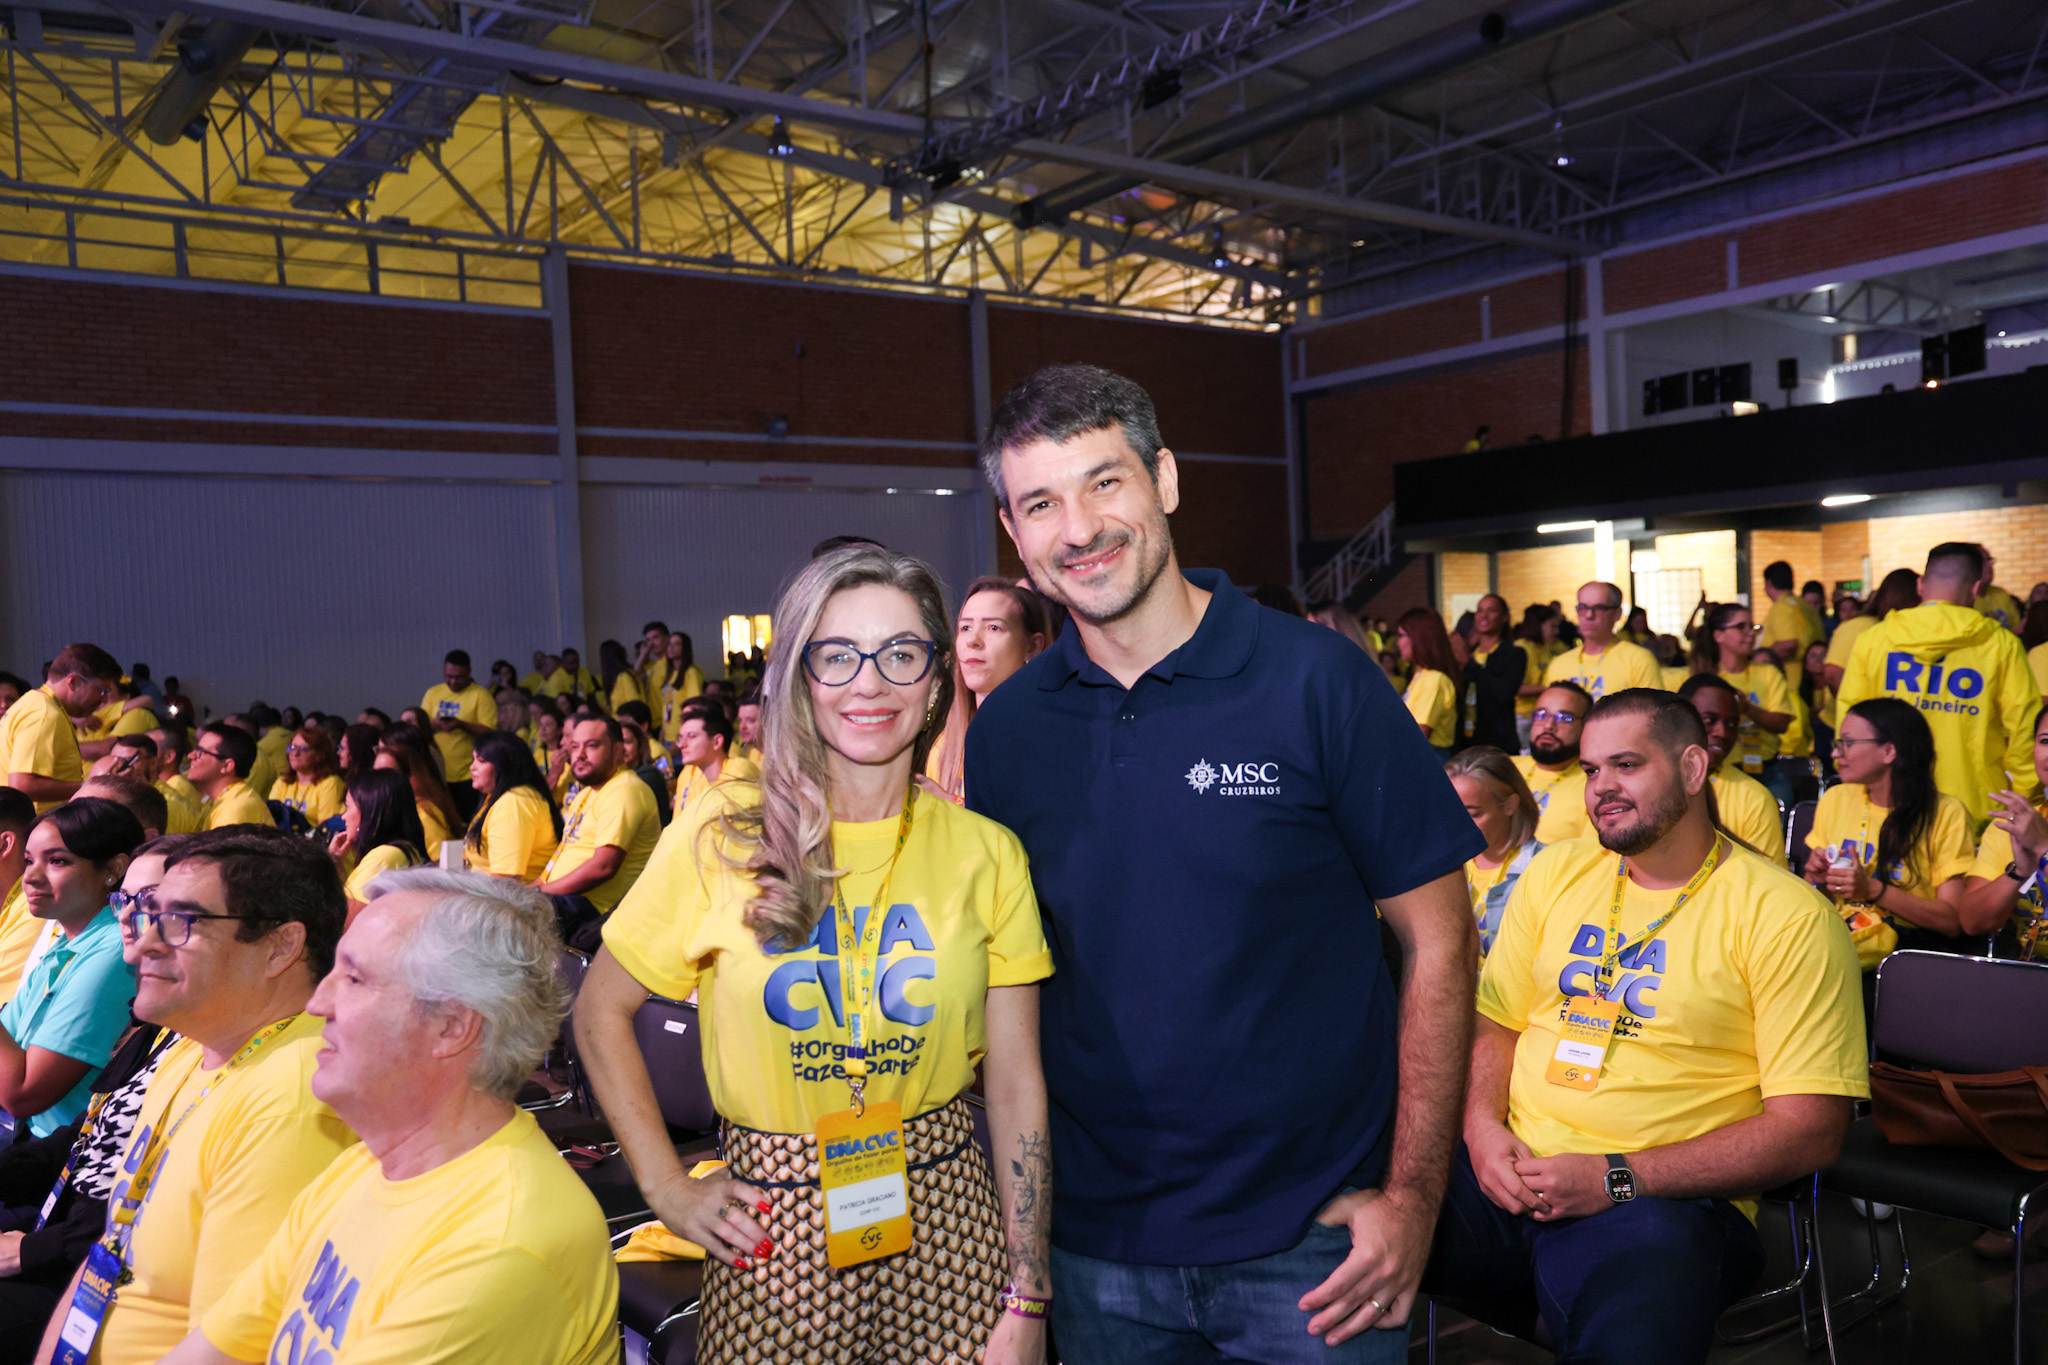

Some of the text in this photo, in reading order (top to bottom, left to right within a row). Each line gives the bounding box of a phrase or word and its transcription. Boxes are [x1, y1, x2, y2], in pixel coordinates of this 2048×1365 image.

[1885, 651, 1984, 699] Rio
[1914, 696, 1980, 716] Janeiro
[1220, 762, 1279, 784] MSC
[1219, 786, 1281, 796] CRUZEIROS
[764, 956, 936, 1032] CVC
[1559, 960, 1662, 1018] CVC
[790, 1034, 926, 1061] #OrglhoDe
[1565, 1070, 1579, 1079] CVC
[826, 1157, 853, 1168] Orgulho
[863, 1151, 880, 1159] fazer
[839, 1200, 866, 1211] PATRICIA
[860, 1231, 883, 1246] CVC
[302, 1238, 360, 1351] DNA
[1020, 1298, 1045, 1314] DNA
[270, 1308, 335, 1365] CV
